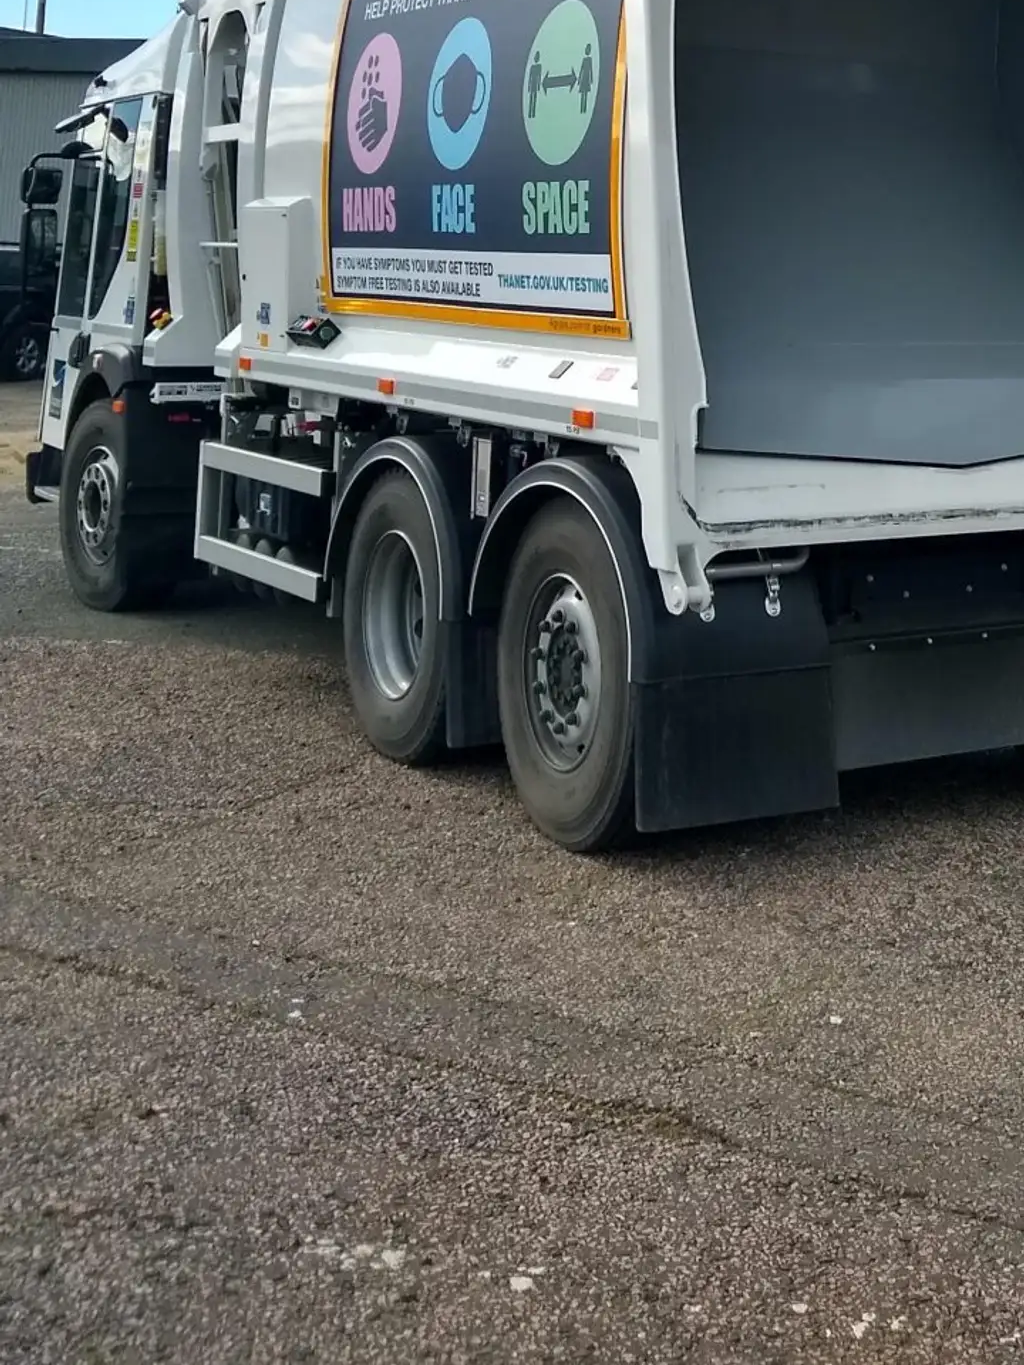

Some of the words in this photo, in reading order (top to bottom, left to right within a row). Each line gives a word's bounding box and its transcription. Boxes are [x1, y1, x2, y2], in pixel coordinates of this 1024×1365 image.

[364, 0, 390, 21] HELP
[342, 185, 397, 233] HANDS
[431, 183, 476, 234] FACE
[522, 179, 590, 235] SPACE
[336, 257, 343, 270] IF
[343, 257, 355, 271] YOU
[356, 257, 373, 271] HAVE
[373, 258, 411, 272] SYMPTOMS
[411, 259, 426, 274] YOU
[427, 260, 447, 275] MUST
[448, 261, 464, 276] GET
[464, 262, 494, 277] TESTED
[336, 275, 367, 290] SYMPTOM
[368, 276, 384, 291] FREE
[385, 277, 413, 292] TESTING
[413, 278, 421, 293] IS
[421, 279, 441, 295] ALSO
[441, 280, 481, 297] AVAILABLE
[498, 274, 609, 294] THANET.GOV.UK/TESTING
